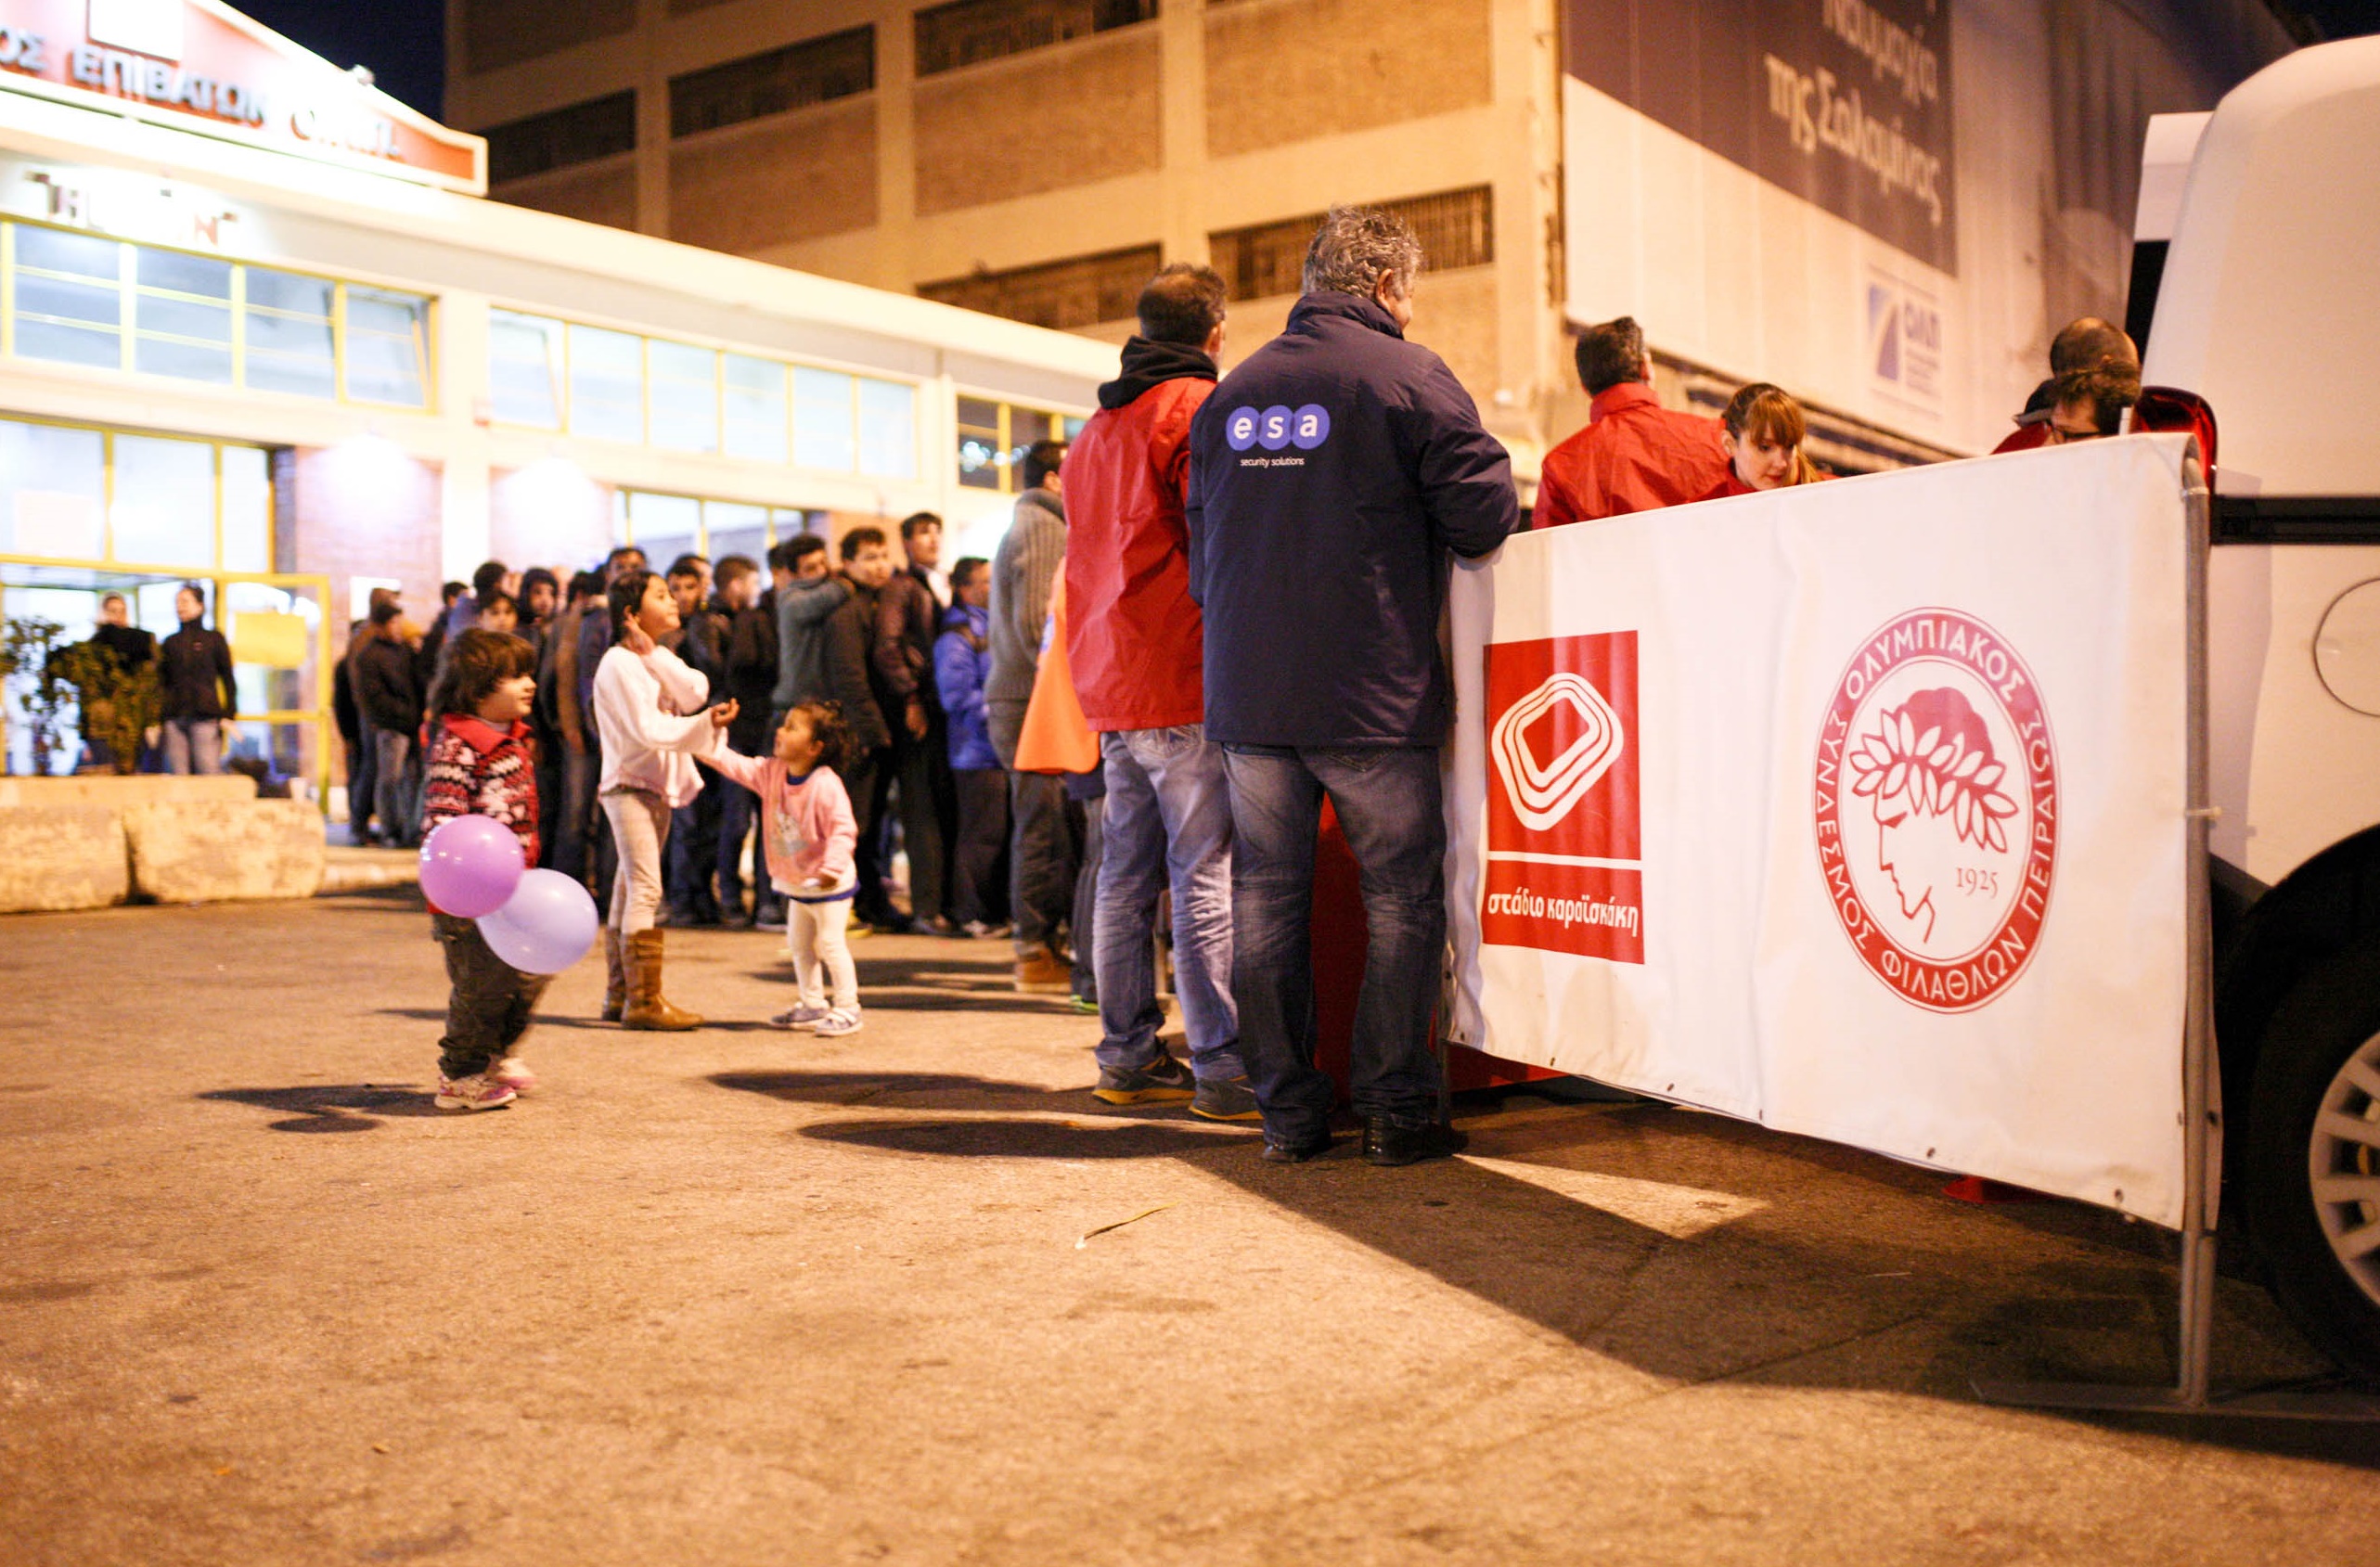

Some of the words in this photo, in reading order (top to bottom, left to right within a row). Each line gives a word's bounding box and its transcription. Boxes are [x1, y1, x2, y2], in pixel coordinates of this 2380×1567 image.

[71, 44, 267, 126] ΕΠΙΒΑΤΩΝ
[1233, 414, 1319, 440] esa
[1240, 457, 1269, 469] security
[1271, 456, 1305, 467] solutions
[1845, 618, 2026, 703] ΟΛΥΜΠΙΑΚΟΣ
[1816, 709, 1876, 951] ΣΥΝΔΕΣΜΟΣ
[1880, 925, 2027, 1003] ΦΙΛΑΘΛΩΝ
[2020, 709, 2054, 921] ΠΕΙΡΑΙΩΣ
[1955, 867, 2000, 899] 1925
[1487, 885, 1545, 919] στάδιο
[1546, 894, 1640, 937] καραϊσκάκη
